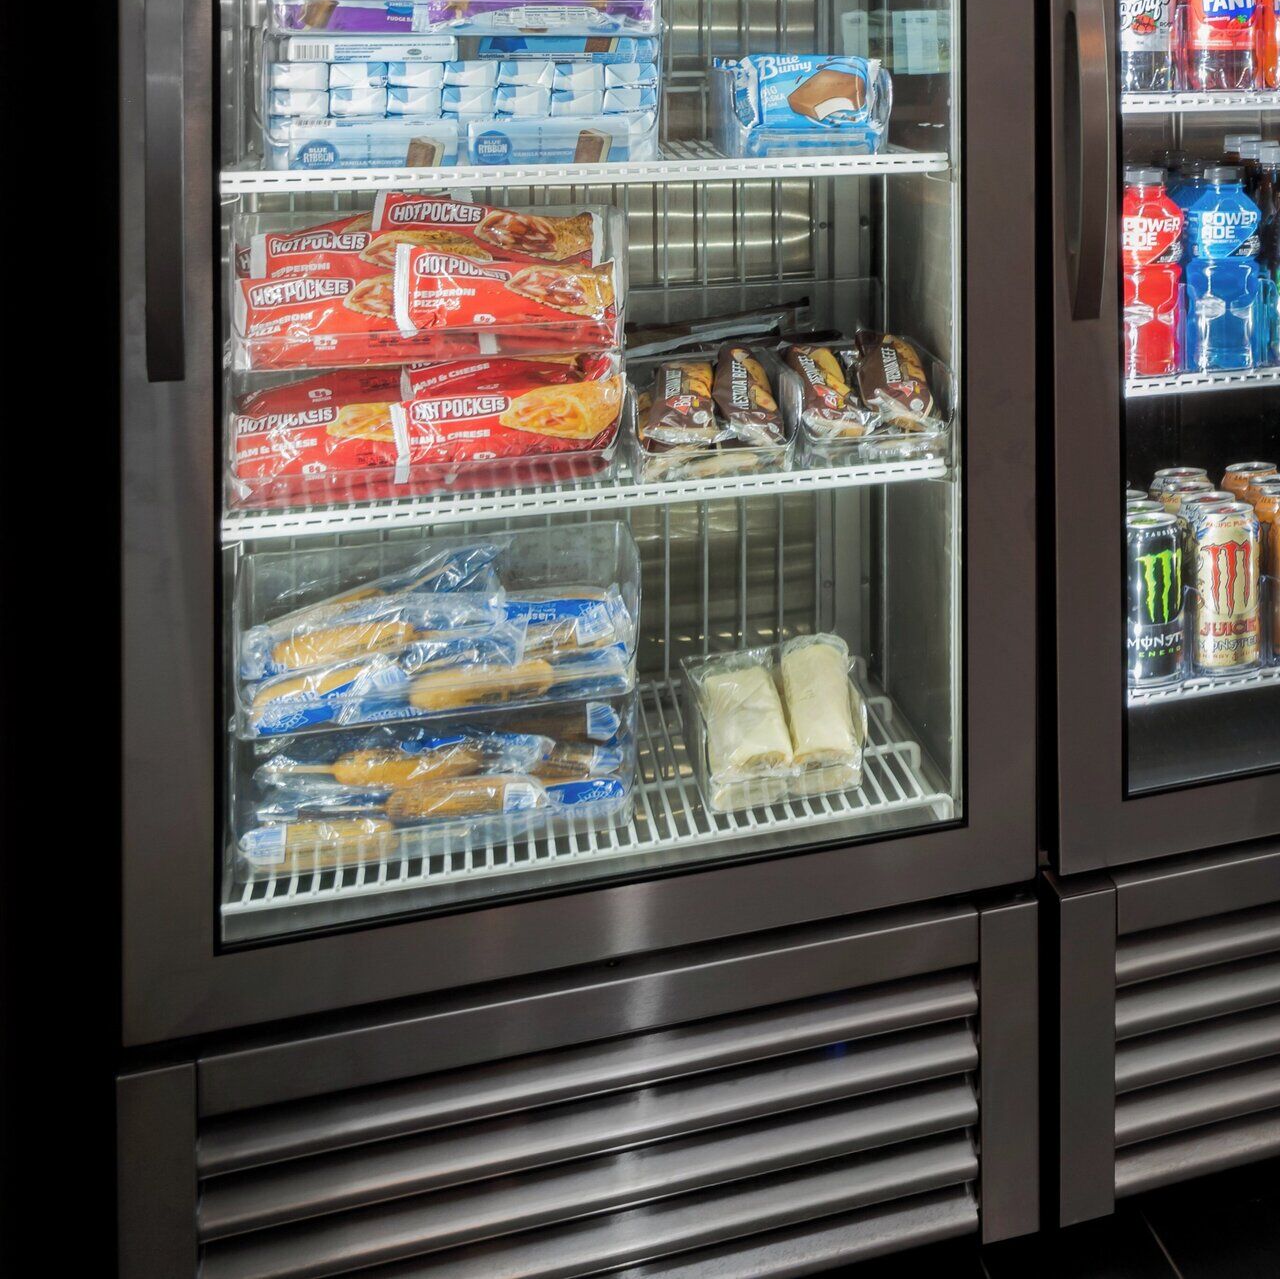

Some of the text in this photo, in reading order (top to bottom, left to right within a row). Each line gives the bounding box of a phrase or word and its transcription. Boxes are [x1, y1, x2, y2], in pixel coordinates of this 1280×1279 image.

[478, 144, 508, 155] RIBBON
[303, 152, 335, 163] RIBBON
[1202, 212, 1258, 227] POWER
[1201, 226, 1236, 240] ADE
[414, 288, 476, 299] PEPPERONI
[438, 375, 448, 383] &
[448, 363, 490, 378] CHEESE
[435, 433, 446, 442] &
[447, 429, 491, 439] CHEESE
[1200, 618, 1257, 637] JUICE
